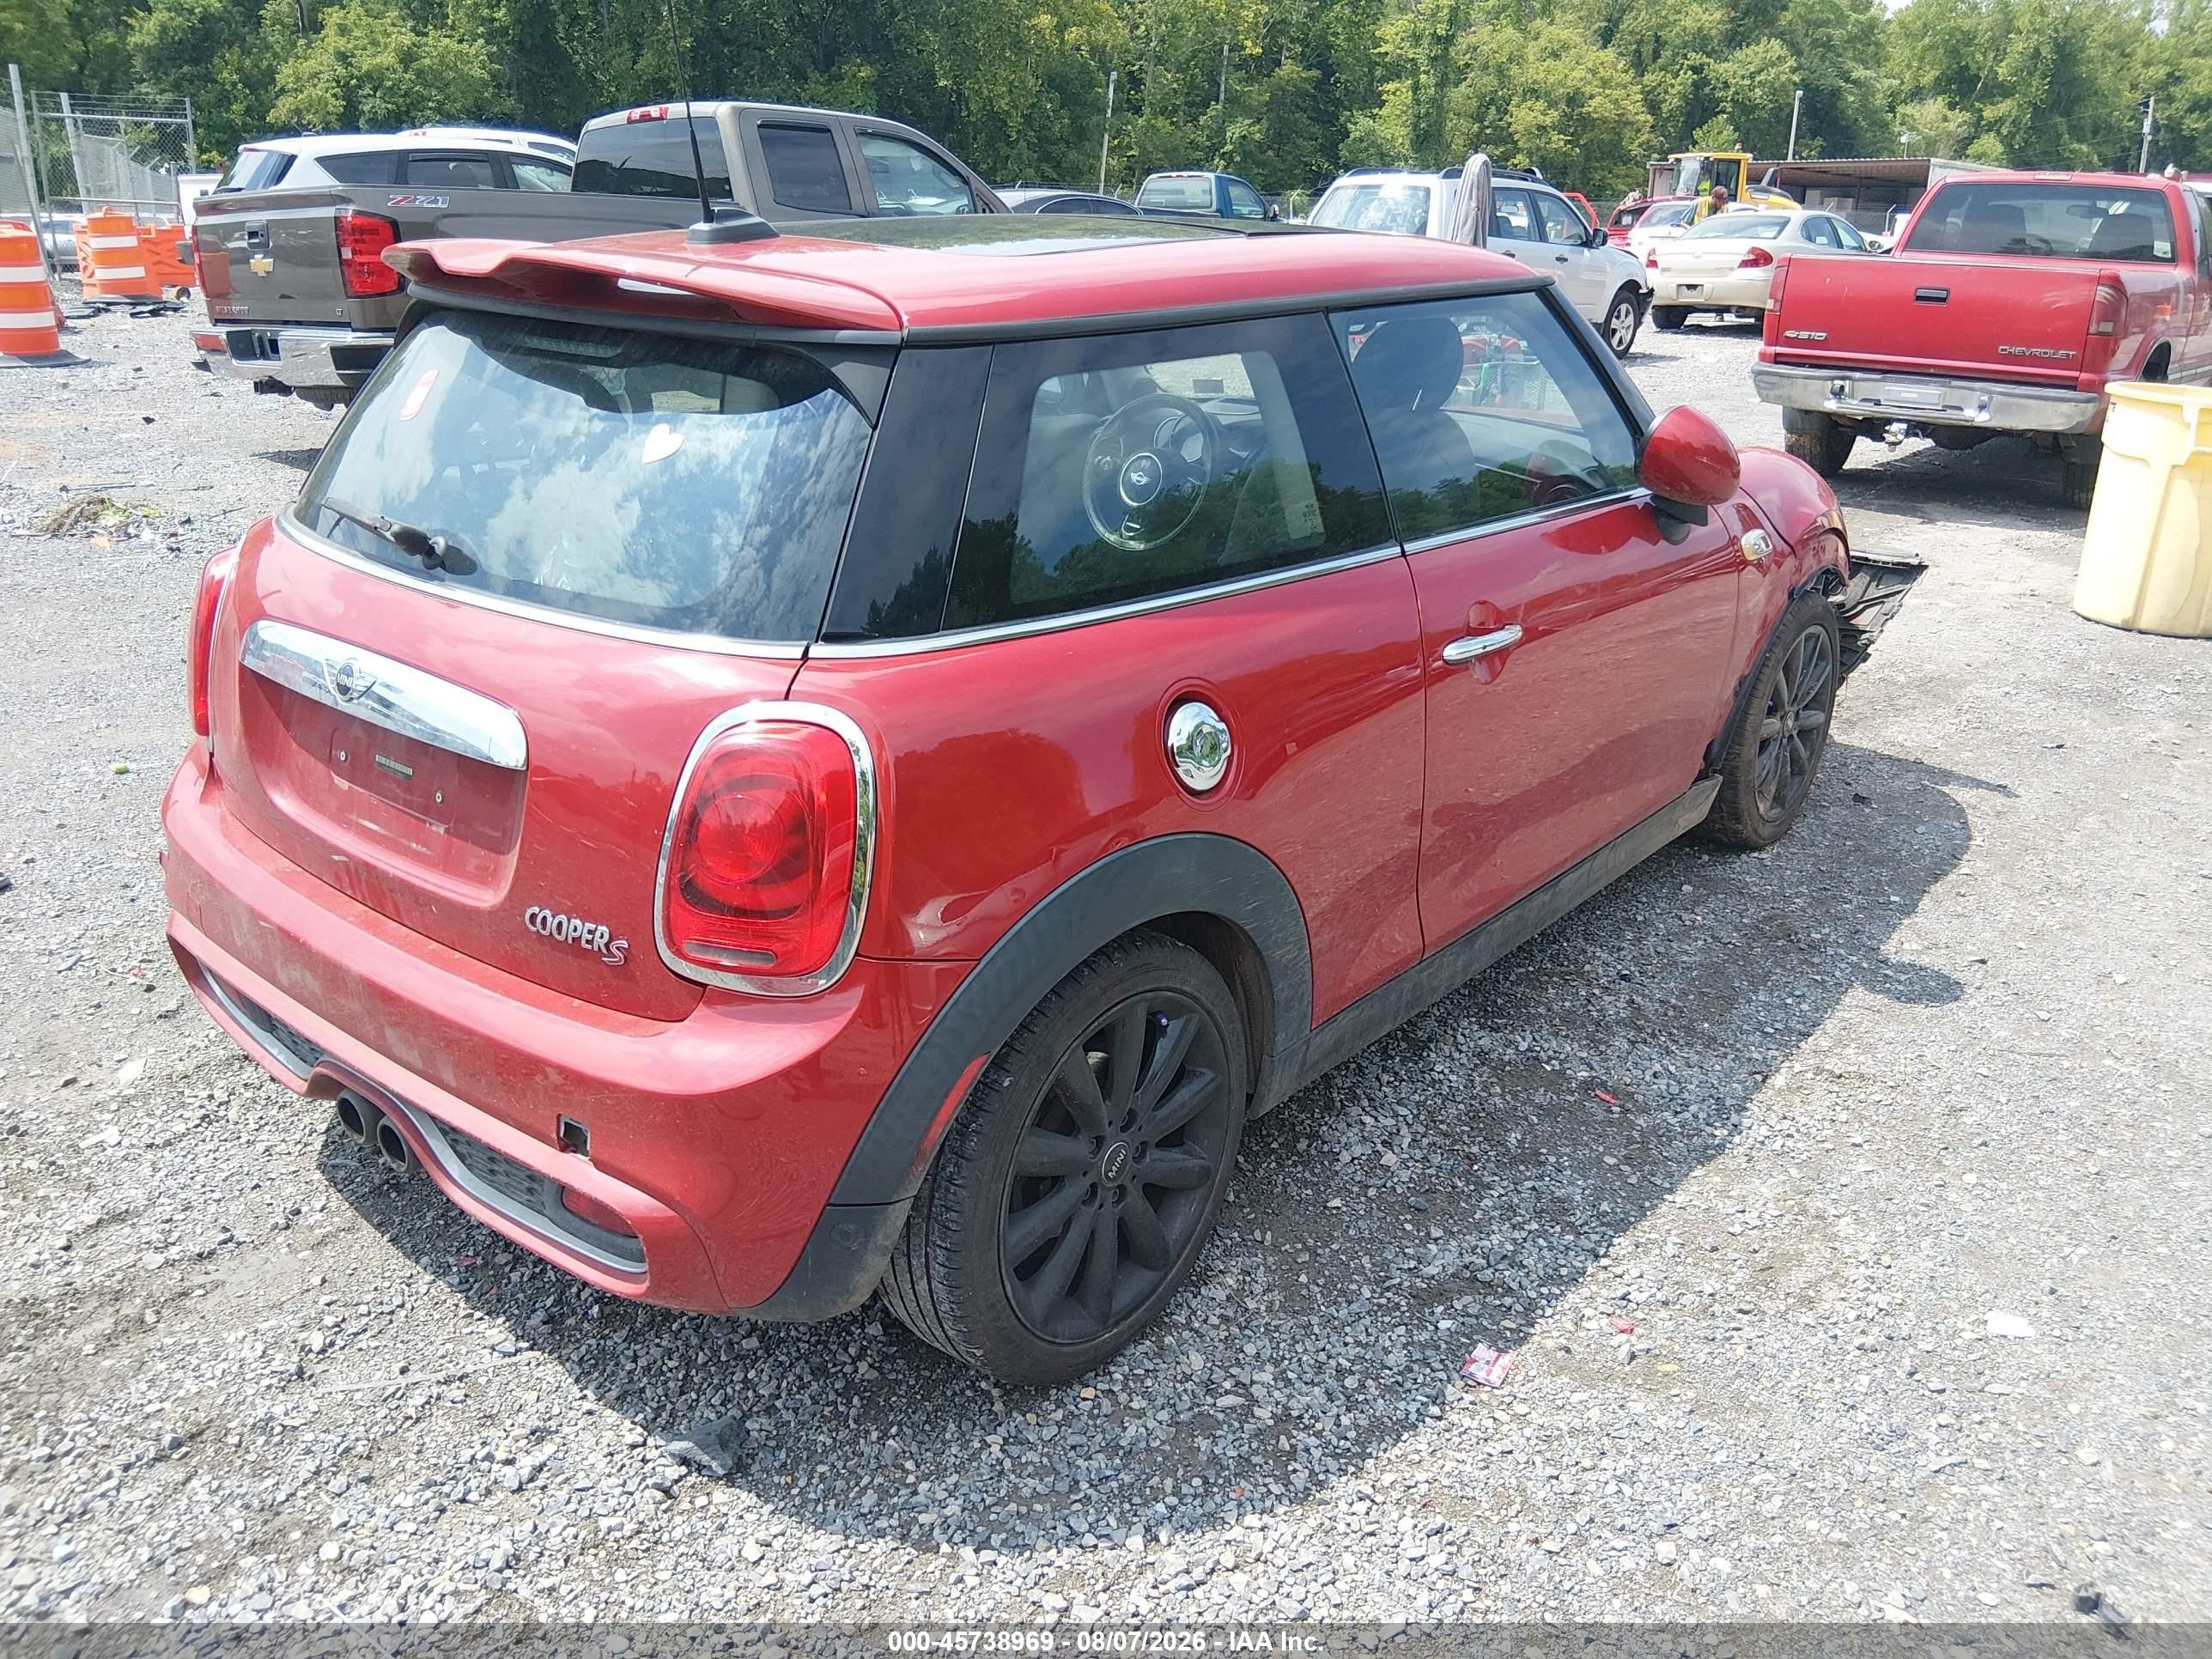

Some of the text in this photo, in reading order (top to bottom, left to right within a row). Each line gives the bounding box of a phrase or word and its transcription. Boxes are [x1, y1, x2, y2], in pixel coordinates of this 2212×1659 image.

[387, 194, 450, 208] Z71
[1998, 345, 2076, 359] CHEVROLET
[525, 906, 629, 965] COOPER S
[1108, 1149, 1127, 1179] MINI
